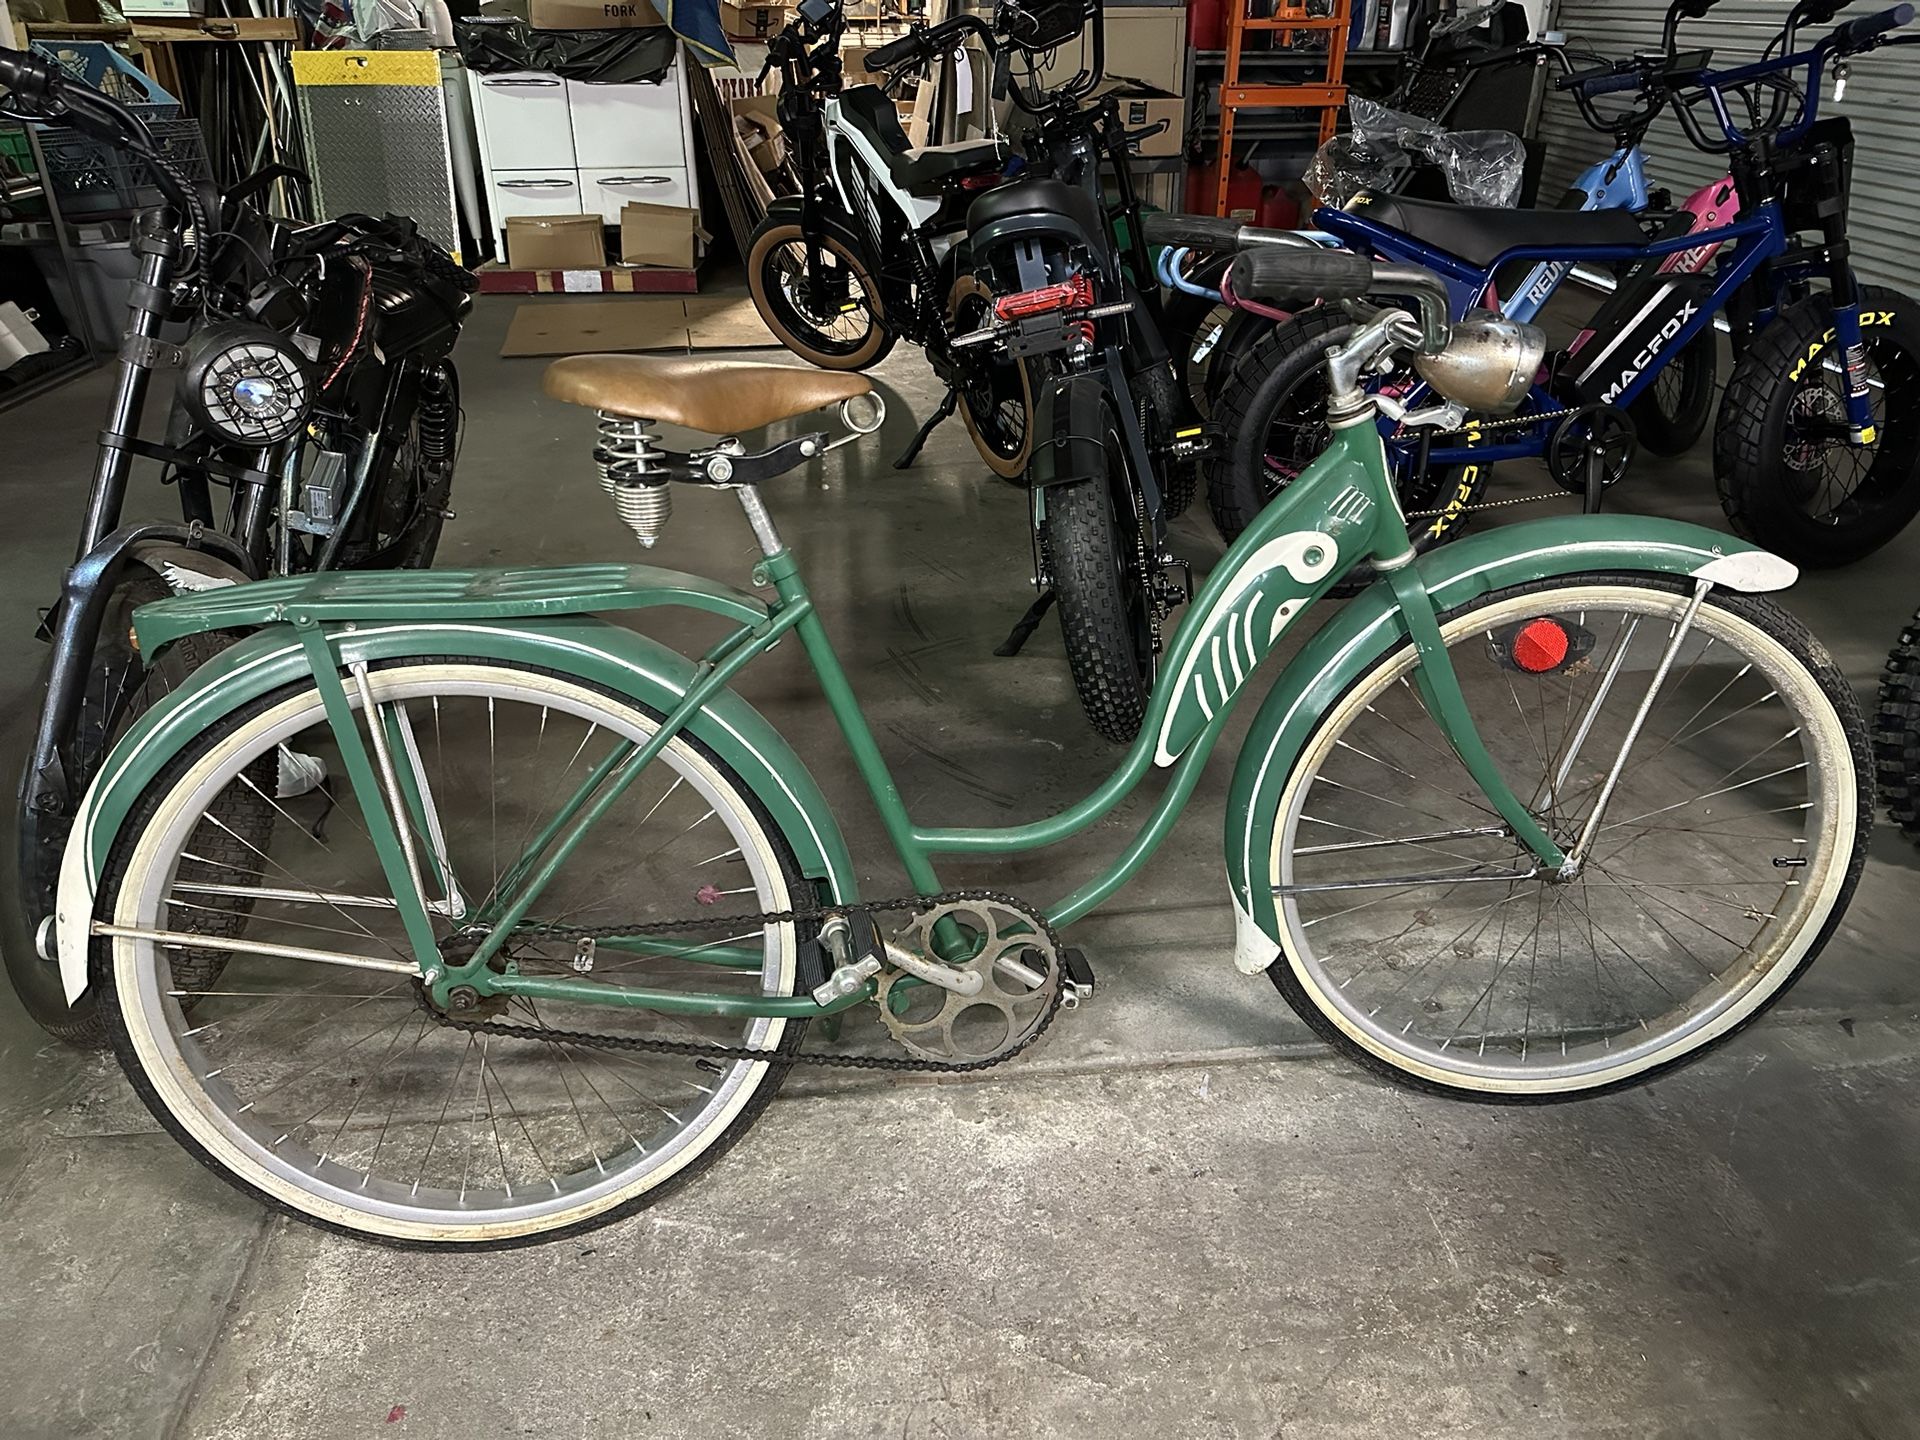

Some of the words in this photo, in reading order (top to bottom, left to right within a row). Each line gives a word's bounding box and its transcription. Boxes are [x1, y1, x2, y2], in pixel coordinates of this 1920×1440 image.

[604, 4, 637, 17] FORK
[1600, 299, 1699, 405] MACFOX
[1788, 311, 1896, 382] MACOX
[1427, 419, 1482, 540] MCFOX
